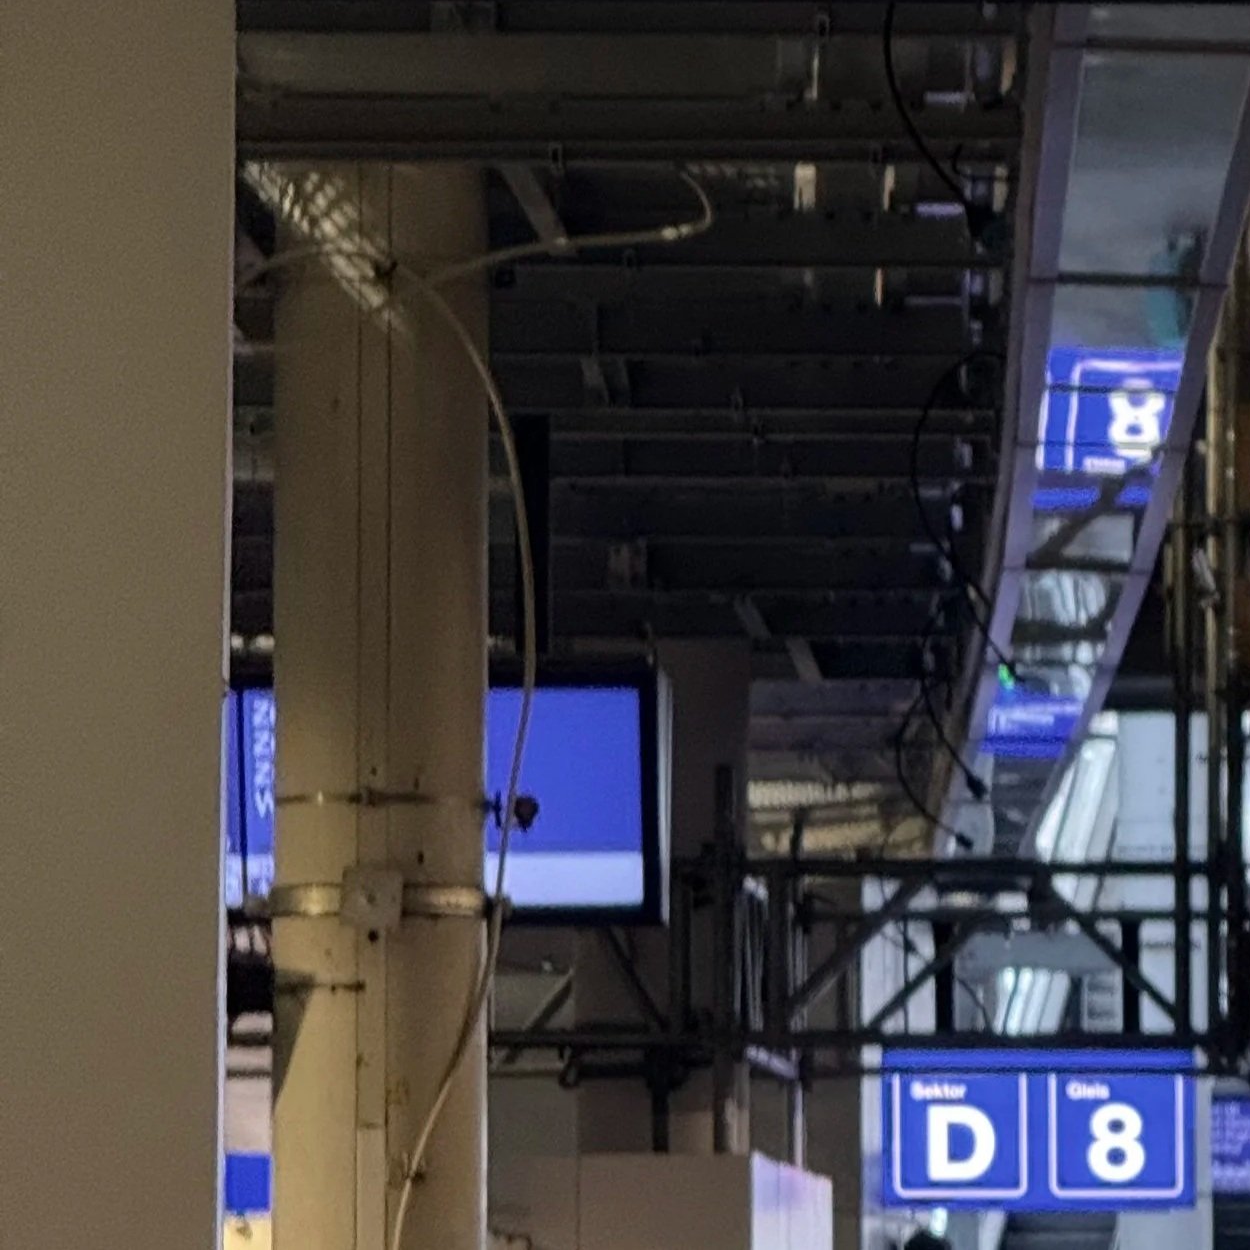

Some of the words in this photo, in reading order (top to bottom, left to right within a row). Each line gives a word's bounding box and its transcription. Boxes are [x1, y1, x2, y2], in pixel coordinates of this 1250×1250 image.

[911, 1081, 966, 1100] Sektor
[1066, 1080, 1109, 1100] Gleis
[928, 1104, 995, 1181] D
[1087, 1103, 1145, 1182] 8
